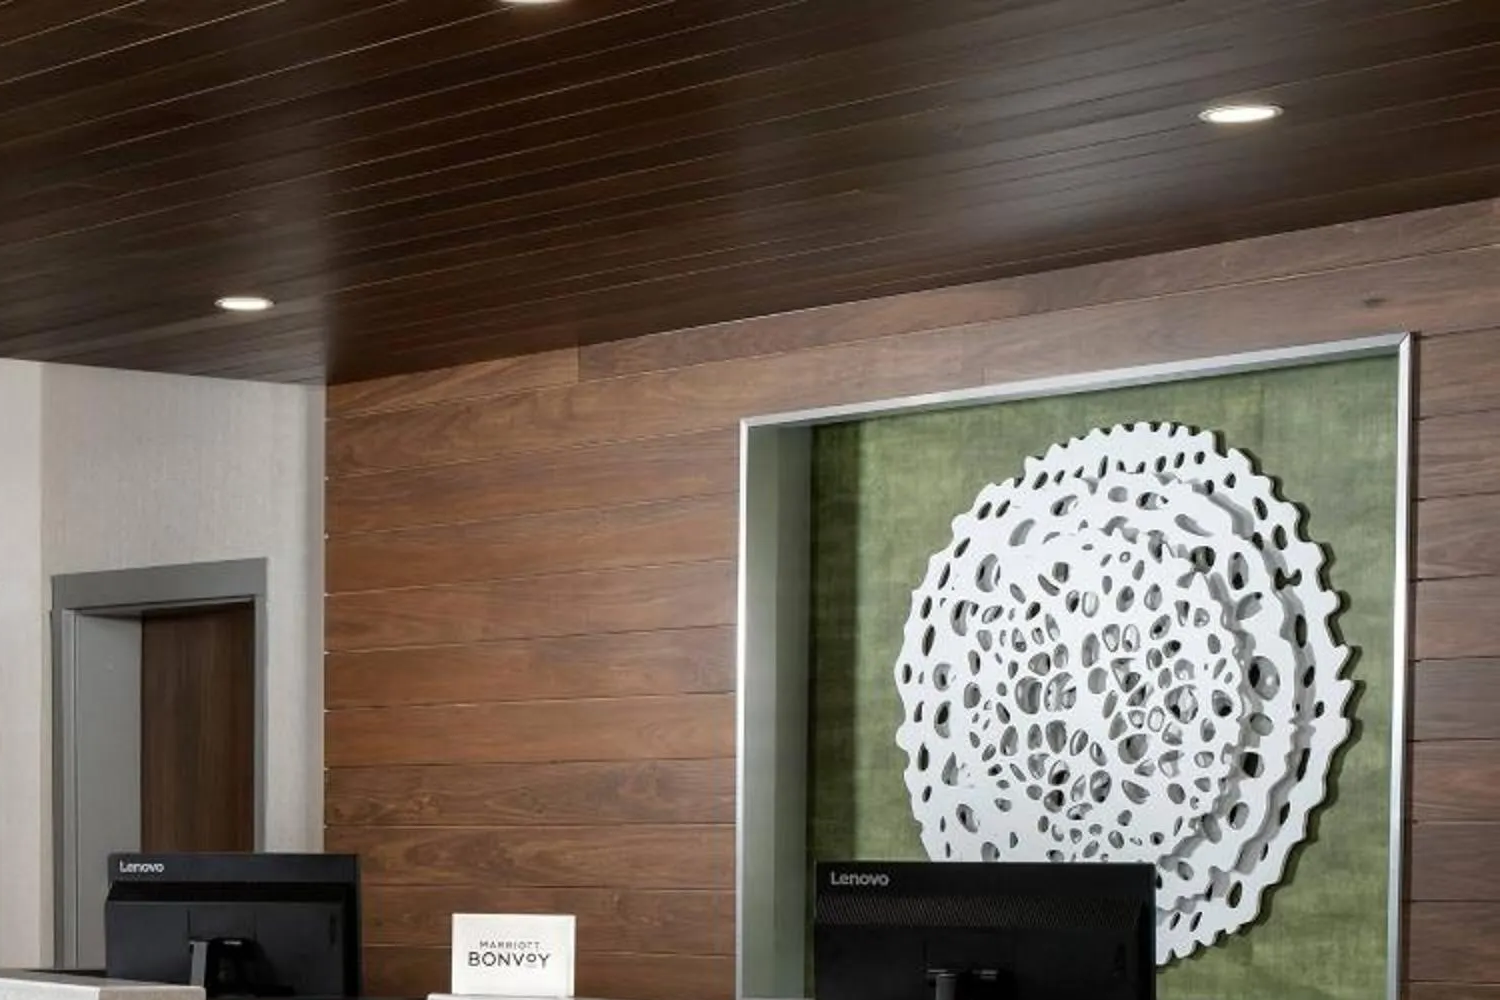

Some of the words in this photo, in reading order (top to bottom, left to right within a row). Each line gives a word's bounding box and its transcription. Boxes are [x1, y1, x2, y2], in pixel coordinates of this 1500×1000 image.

[119, 859, 165, 873] Lenovo
[831, 871, 890, 886] Lenovo
[479, 941, 541, 950] MARRIOTT
